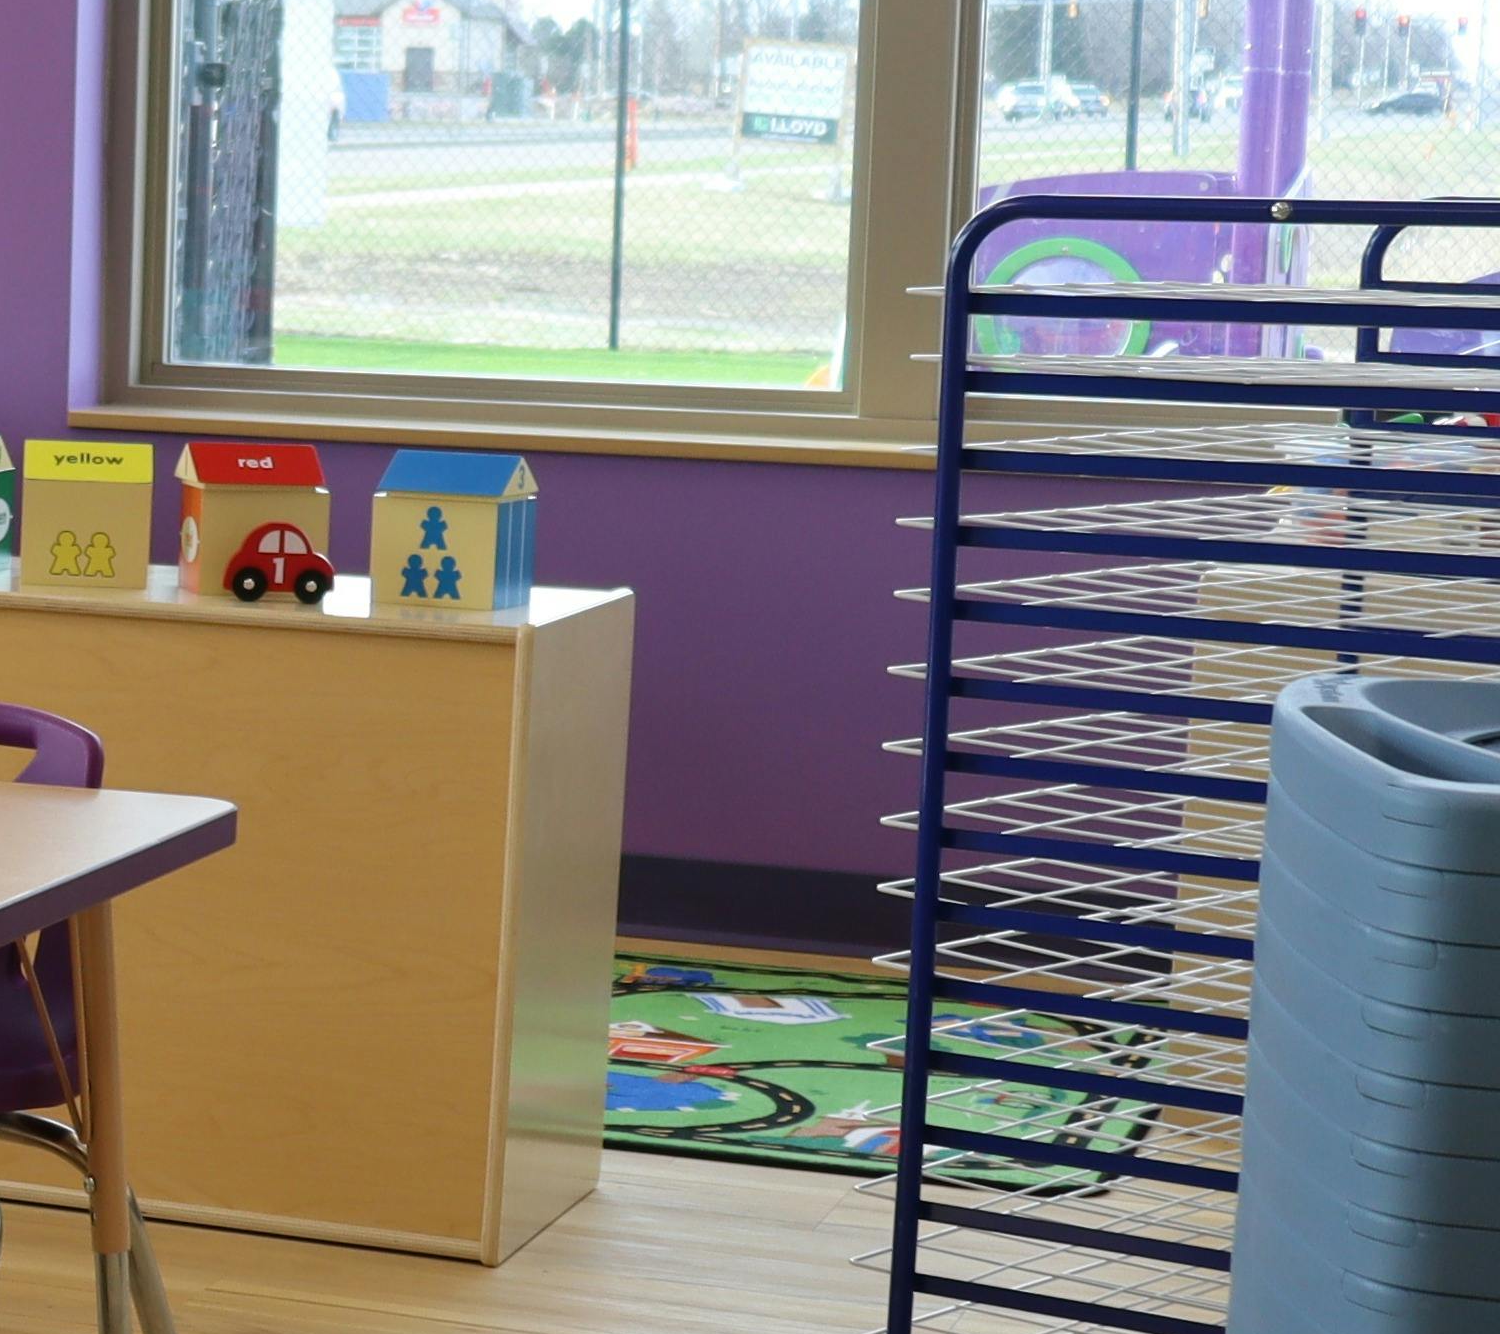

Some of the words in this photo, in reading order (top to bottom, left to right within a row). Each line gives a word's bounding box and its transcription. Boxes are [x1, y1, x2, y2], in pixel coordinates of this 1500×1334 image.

[53, 452, 124, 466] yellow
[238, 456, 273, 470] red
[516, 465, 527, 490] 3
[272, 556, 285, 584] 1
